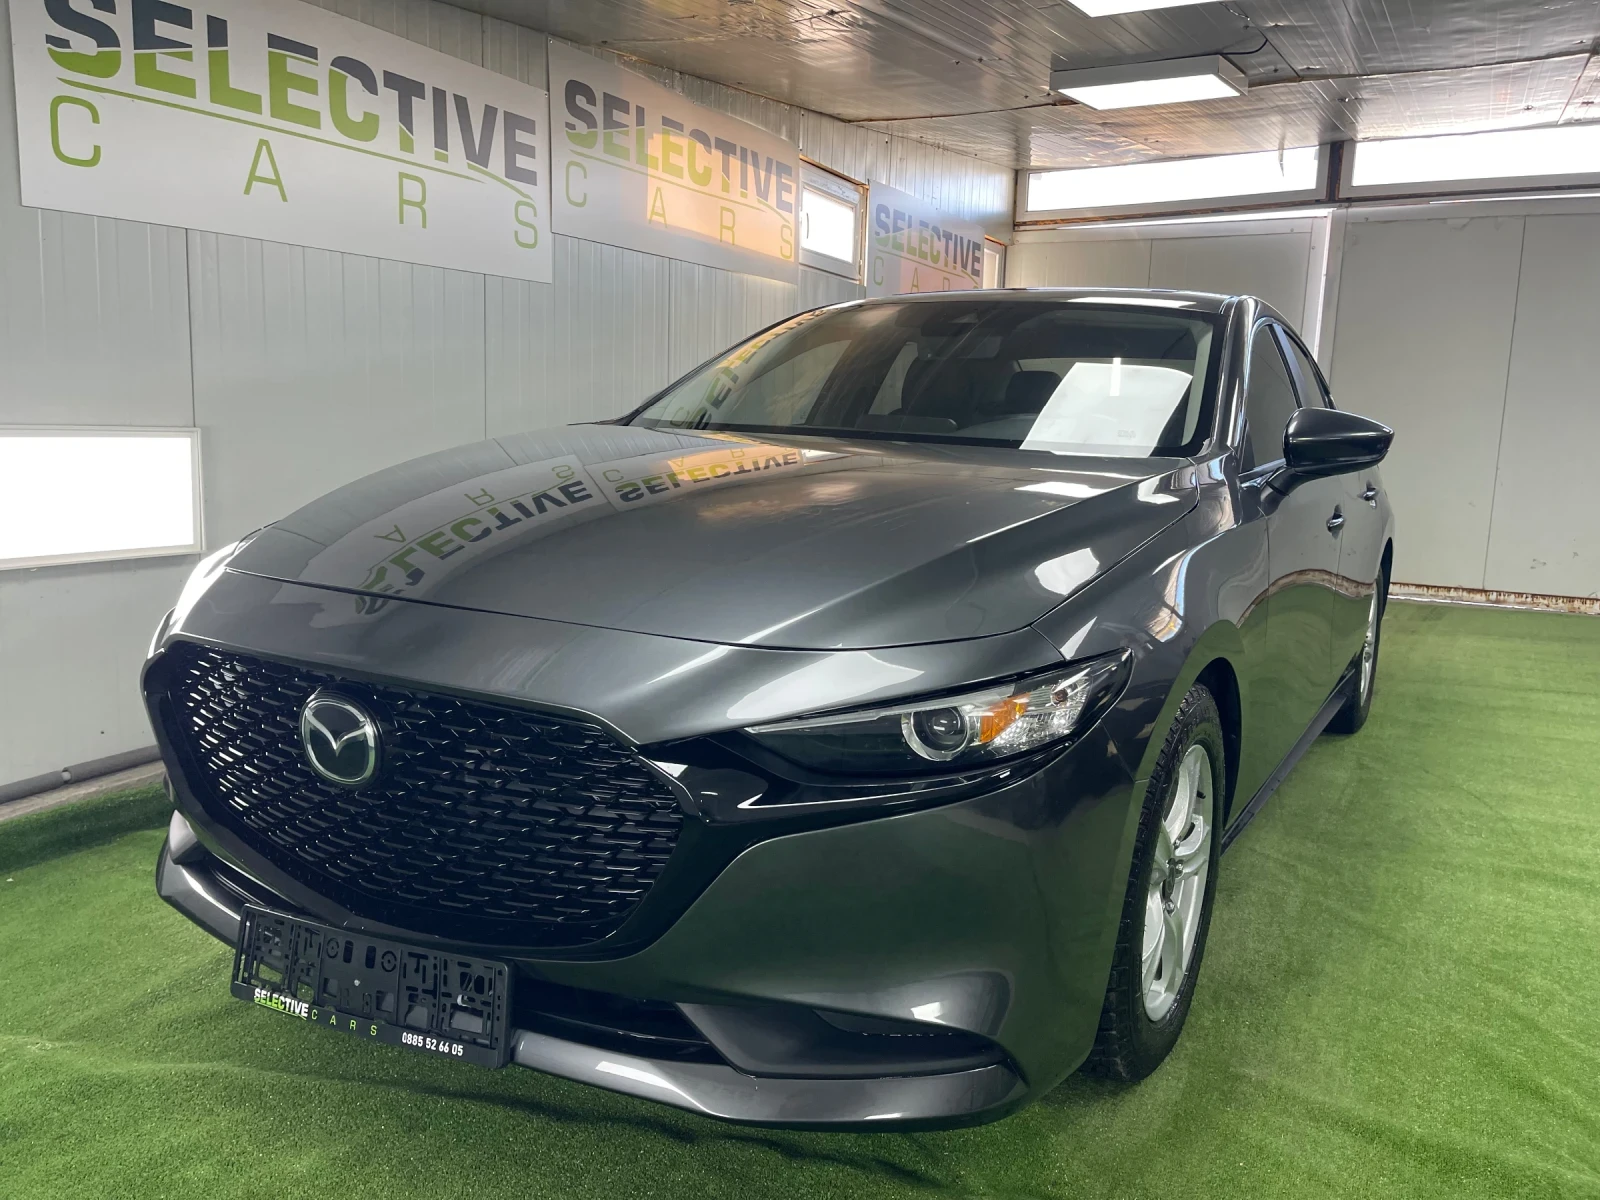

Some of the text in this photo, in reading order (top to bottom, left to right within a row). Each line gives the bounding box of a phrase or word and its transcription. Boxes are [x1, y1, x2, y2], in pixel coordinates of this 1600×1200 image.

[45, 0, 538, 186] SELECTIVE
[50, 95, 538, 249] CARS
[564, 79, 793, 214] SELECTIVE
[565, 161, 793, 260] CARS
[875, 203, 981, 277] SELECTIVE
[873, 255, 979, 293] CA
[254, 988, 464, 1057] SELECTIVE CARS 0885 52 66 05
